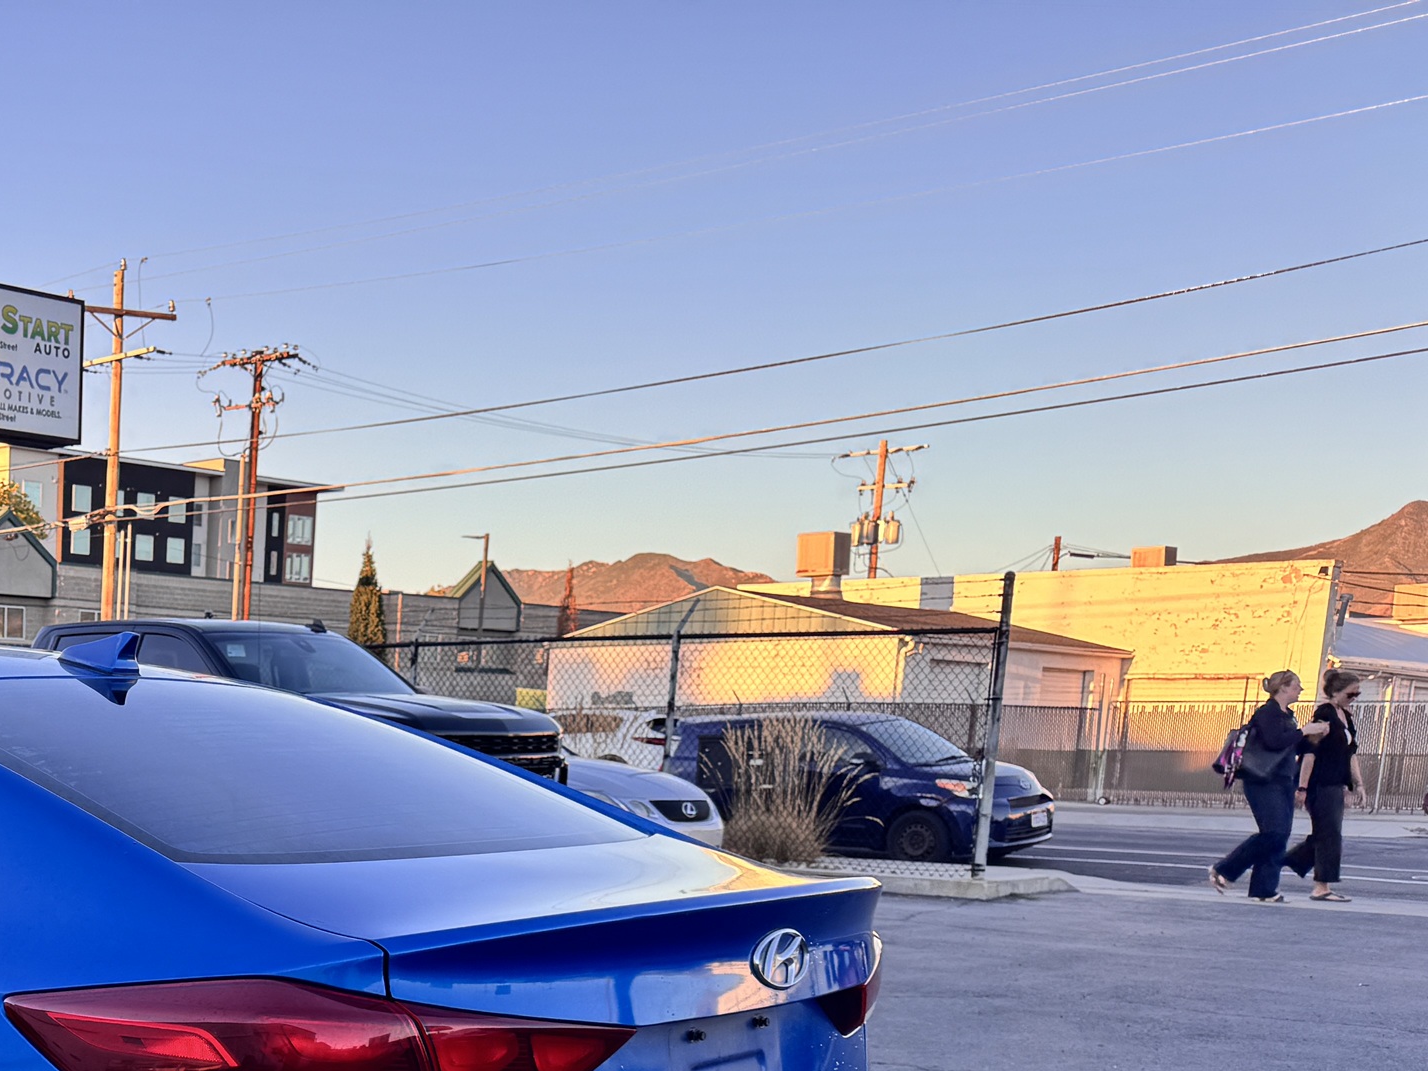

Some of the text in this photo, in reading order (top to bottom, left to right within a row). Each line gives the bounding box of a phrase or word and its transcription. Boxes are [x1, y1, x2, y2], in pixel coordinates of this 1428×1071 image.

[1, 304, 74, 346] START
[0, 341, 18, 351] Street
[34, 342, 70, 359] AUTO
[7, 404, 29, 414] MAKES
